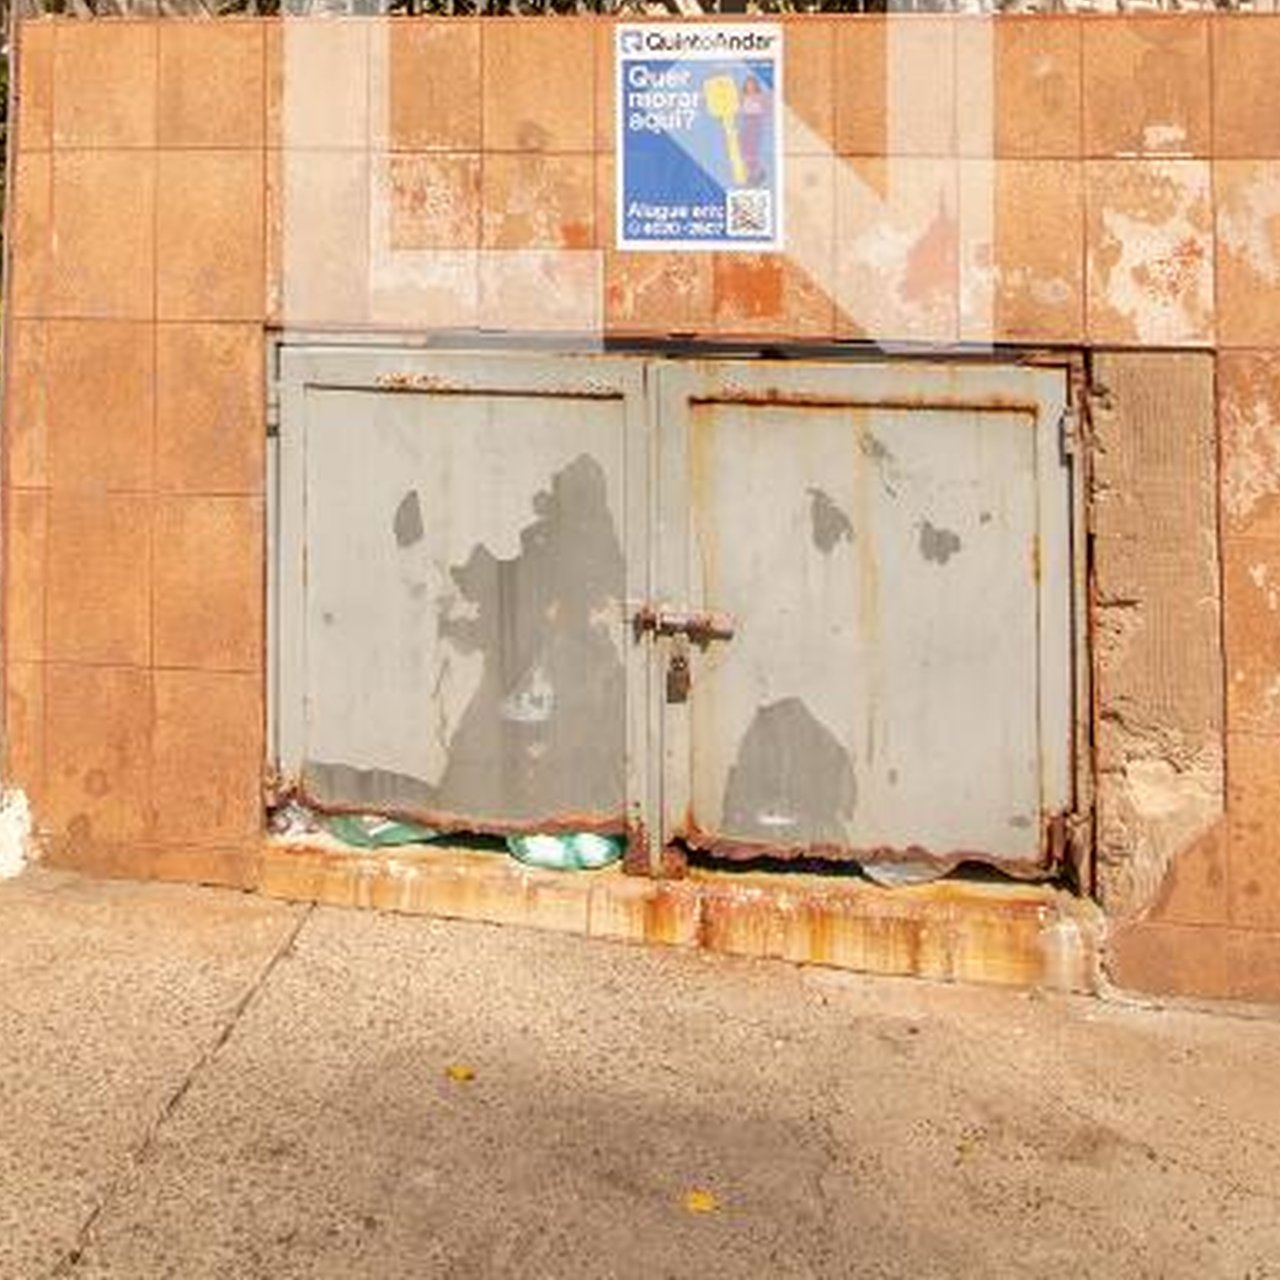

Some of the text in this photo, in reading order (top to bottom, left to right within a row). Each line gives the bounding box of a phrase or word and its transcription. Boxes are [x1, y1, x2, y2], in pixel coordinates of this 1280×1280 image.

[646, 32, 775, 51] QuintoAndar
[629, 65, 691, 89] Quer
[629, 92, 699, 108] morar
[629, 108, 694, 135] aqui?
